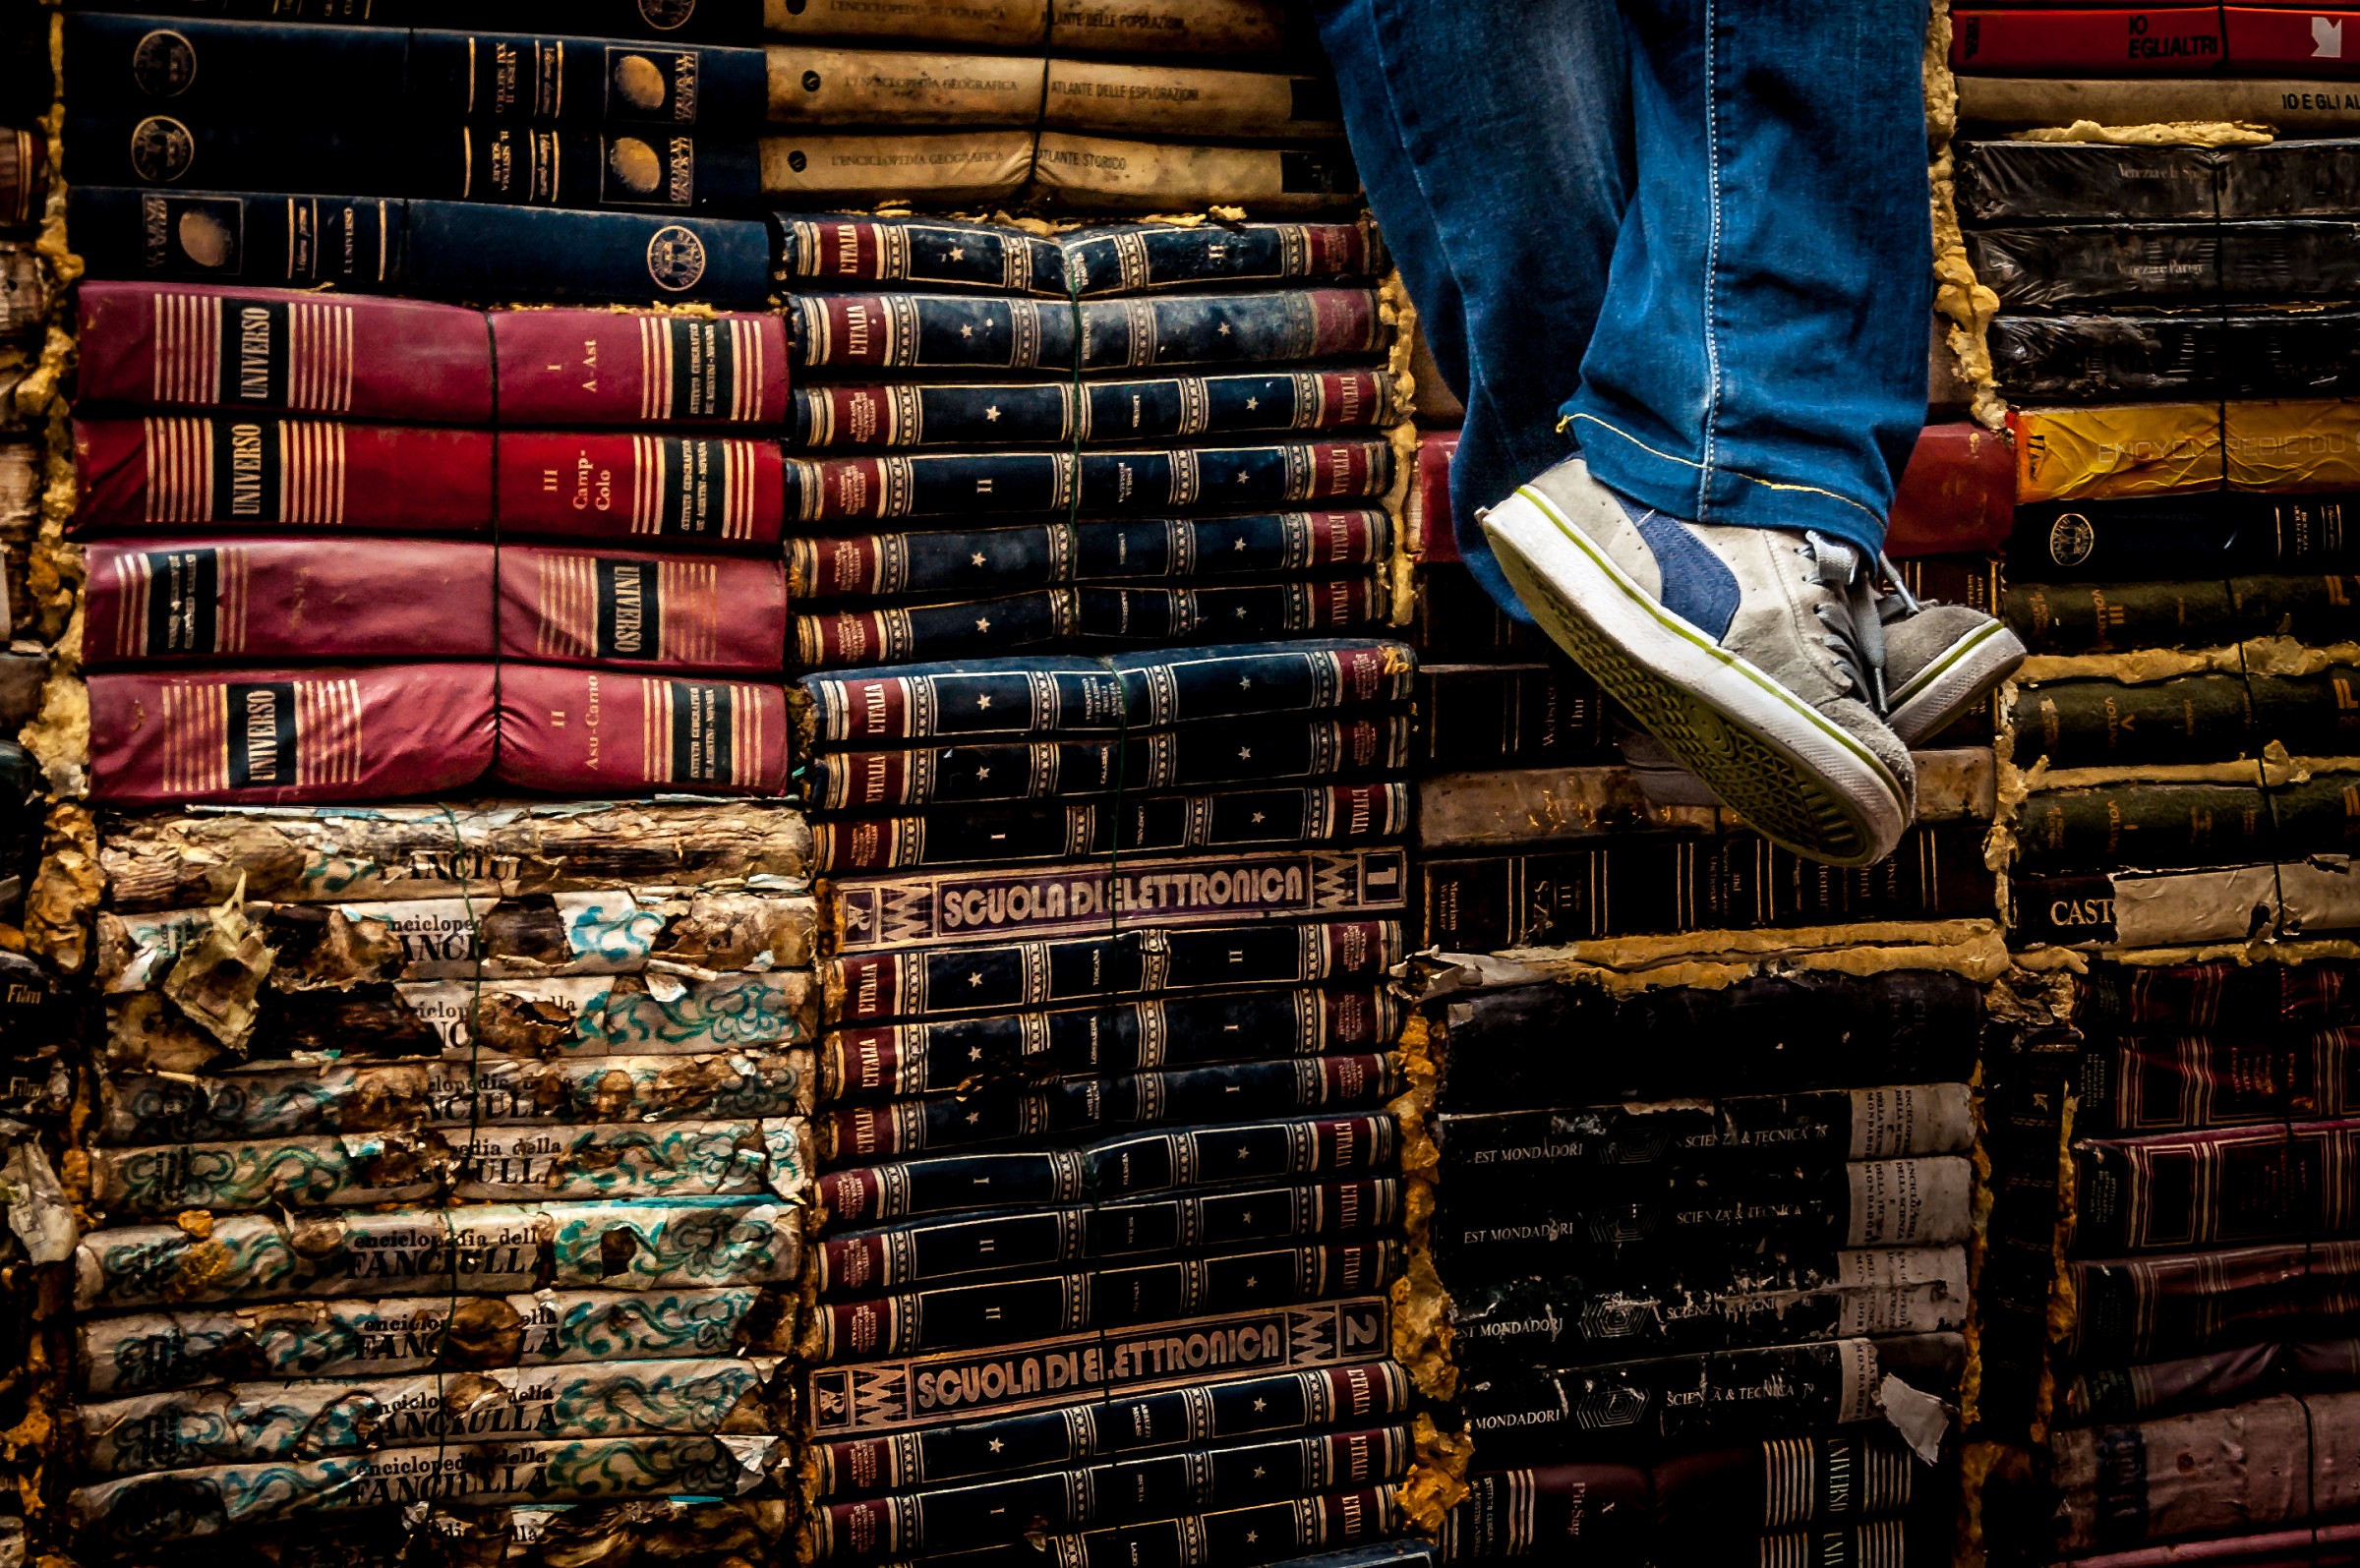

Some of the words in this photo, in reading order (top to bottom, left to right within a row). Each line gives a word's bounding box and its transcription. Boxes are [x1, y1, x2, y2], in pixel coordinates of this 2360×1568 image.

[2128, 16, 2149, 36] IO
[1096, 84, 1126, 98] DELLE
[2281, 93, 2300, 110] IO
[2303, 93, 2314, 110] E
[2316, 93, 2341, 110] GLI
[1083, 154, 1127, 170] STORICO
[837, 224, 859, 273] L'ITALIA
[847, 305, 867, 355] L'ITALIA
[241, 307, 269, 399] UNIVERSO
[582, 339, 597, 393] A-Ast
[1339, 376, 1360, 424] L'ITALIA
[2308, 434, 2346, 455] DU
[232, 423, 262, 515] UNIVERSO
[542, 468, 559, 493] III
[595, 469, 612, 511] Colo
[1330, 447, 1349, 495] L'ITALIA
[1328, 513, 1349, 562] L'ITALIA
[614, 565, 641, 653] UNIVERSO
[1329, 579, 1349, 629] L'ITALIA
[551, 710, 566, 727] II
[866, 684, 886, 732] L'ITALIA
[246, 689, 278, 783] UNIVERSO
[865, 755, 885, 804] L'ITALIA
[943, 887, 1066, 930] SCUOLA
[1072, 891, 1103, 915] DI
[1105, 866, 1305, 912] ELETTRONICA
[2049, 899, 2114, 926] CAST
[1229, 950, 1244, 964] II
[859, 963, 877, 1014] L'ITALIA
[859, 1038, 878, 1089] L'ITALIA
[512, 1136, 563, 1155] della
[1335, 1122, 1352, 1166] L'ITALIA
[1474, 1150, 1498, 1164] EST
[1501, 1141, 1583, 1162] MONDADORI
[1754, 1127, 1807, 1146] TECNICA
[1341, 1184, 1358, 1229] L'ITALIA
[1747, 1203, 1802, 1220] TECNICA
[1464, 1230, 1487, 1245] EST
[1490, 1222, 1573, 1242] MONDADORI
[1343, 1247, 1360, 1291] L'ITALIA
[1345, 1317, 1379, 1346] 2
[1479, 1316, 1564, 1339] MONDADORI
[916, 1367, 1044, 1408] SCUOLA
[1046, 1360, 1079, 1385] DI
[1083, 1322, 1280, 1382] ELETTRONICA
[1345, 1368, 1369, 1416] L'ITALIA
[1725, 1388, 1736, 1401] &
[1738, 1383, 1795, 1401] TECNICA
[1474, 1409, 1561, 1430] MONDADORI
[499, 1446, 548, 1465] della
[1348, 1435, 1369, 1482] L'ITALIA
[1828, 1437, 1851, 1512] UNIVERSO
[1601, 1501, 1616, 1515] X
